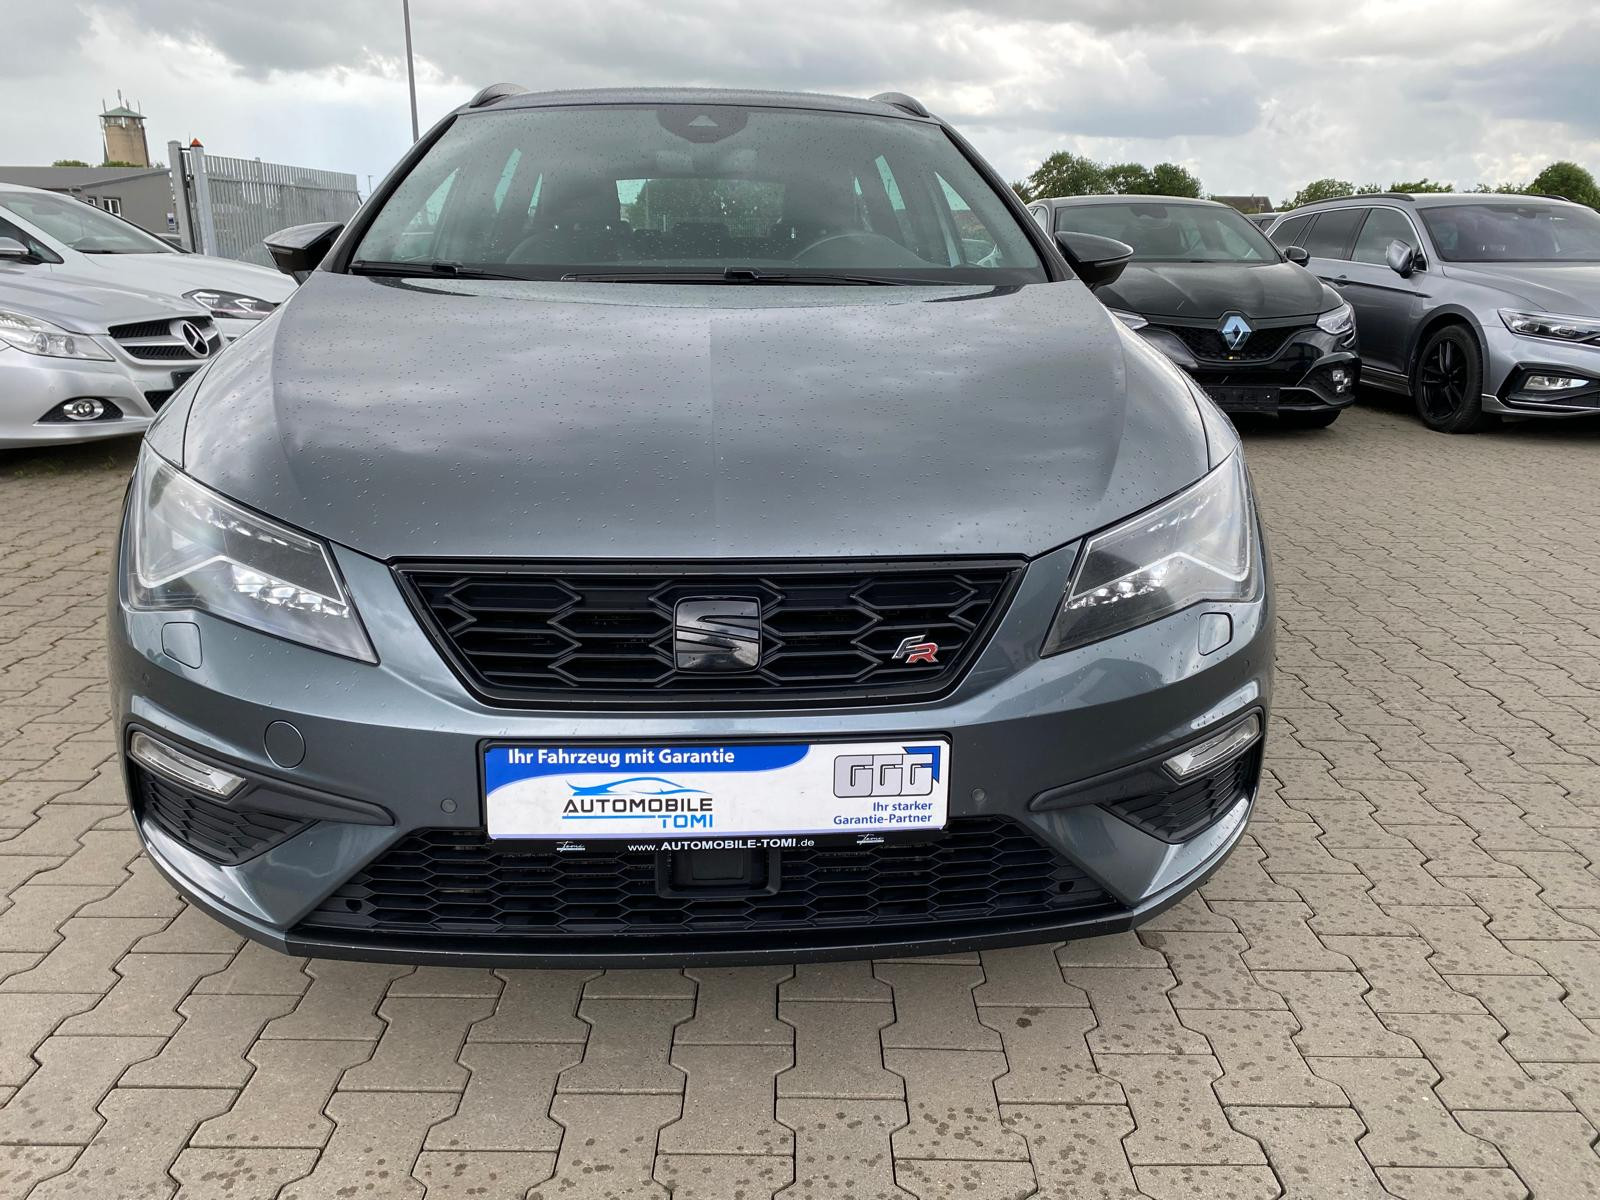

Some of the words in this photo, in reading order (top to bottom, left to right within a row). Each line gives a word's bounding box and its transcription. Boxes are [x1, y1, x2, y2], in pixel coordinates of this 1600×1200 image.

[508, 748, 533, 764] Ihr
[538, 748, 620, 768] Fahrzeug
[625, 748, 654, 764] mit
[659, 748, 735, 764] Garantie
[563, 797, 713, 813] AUTOMOBILE
[873, 802, 889, 812] Ihr
[892, 801, 933, 812] starker
[657, 814, 713, 829] TOMI
[833, 813, 933, 825] Garantie-Partner
